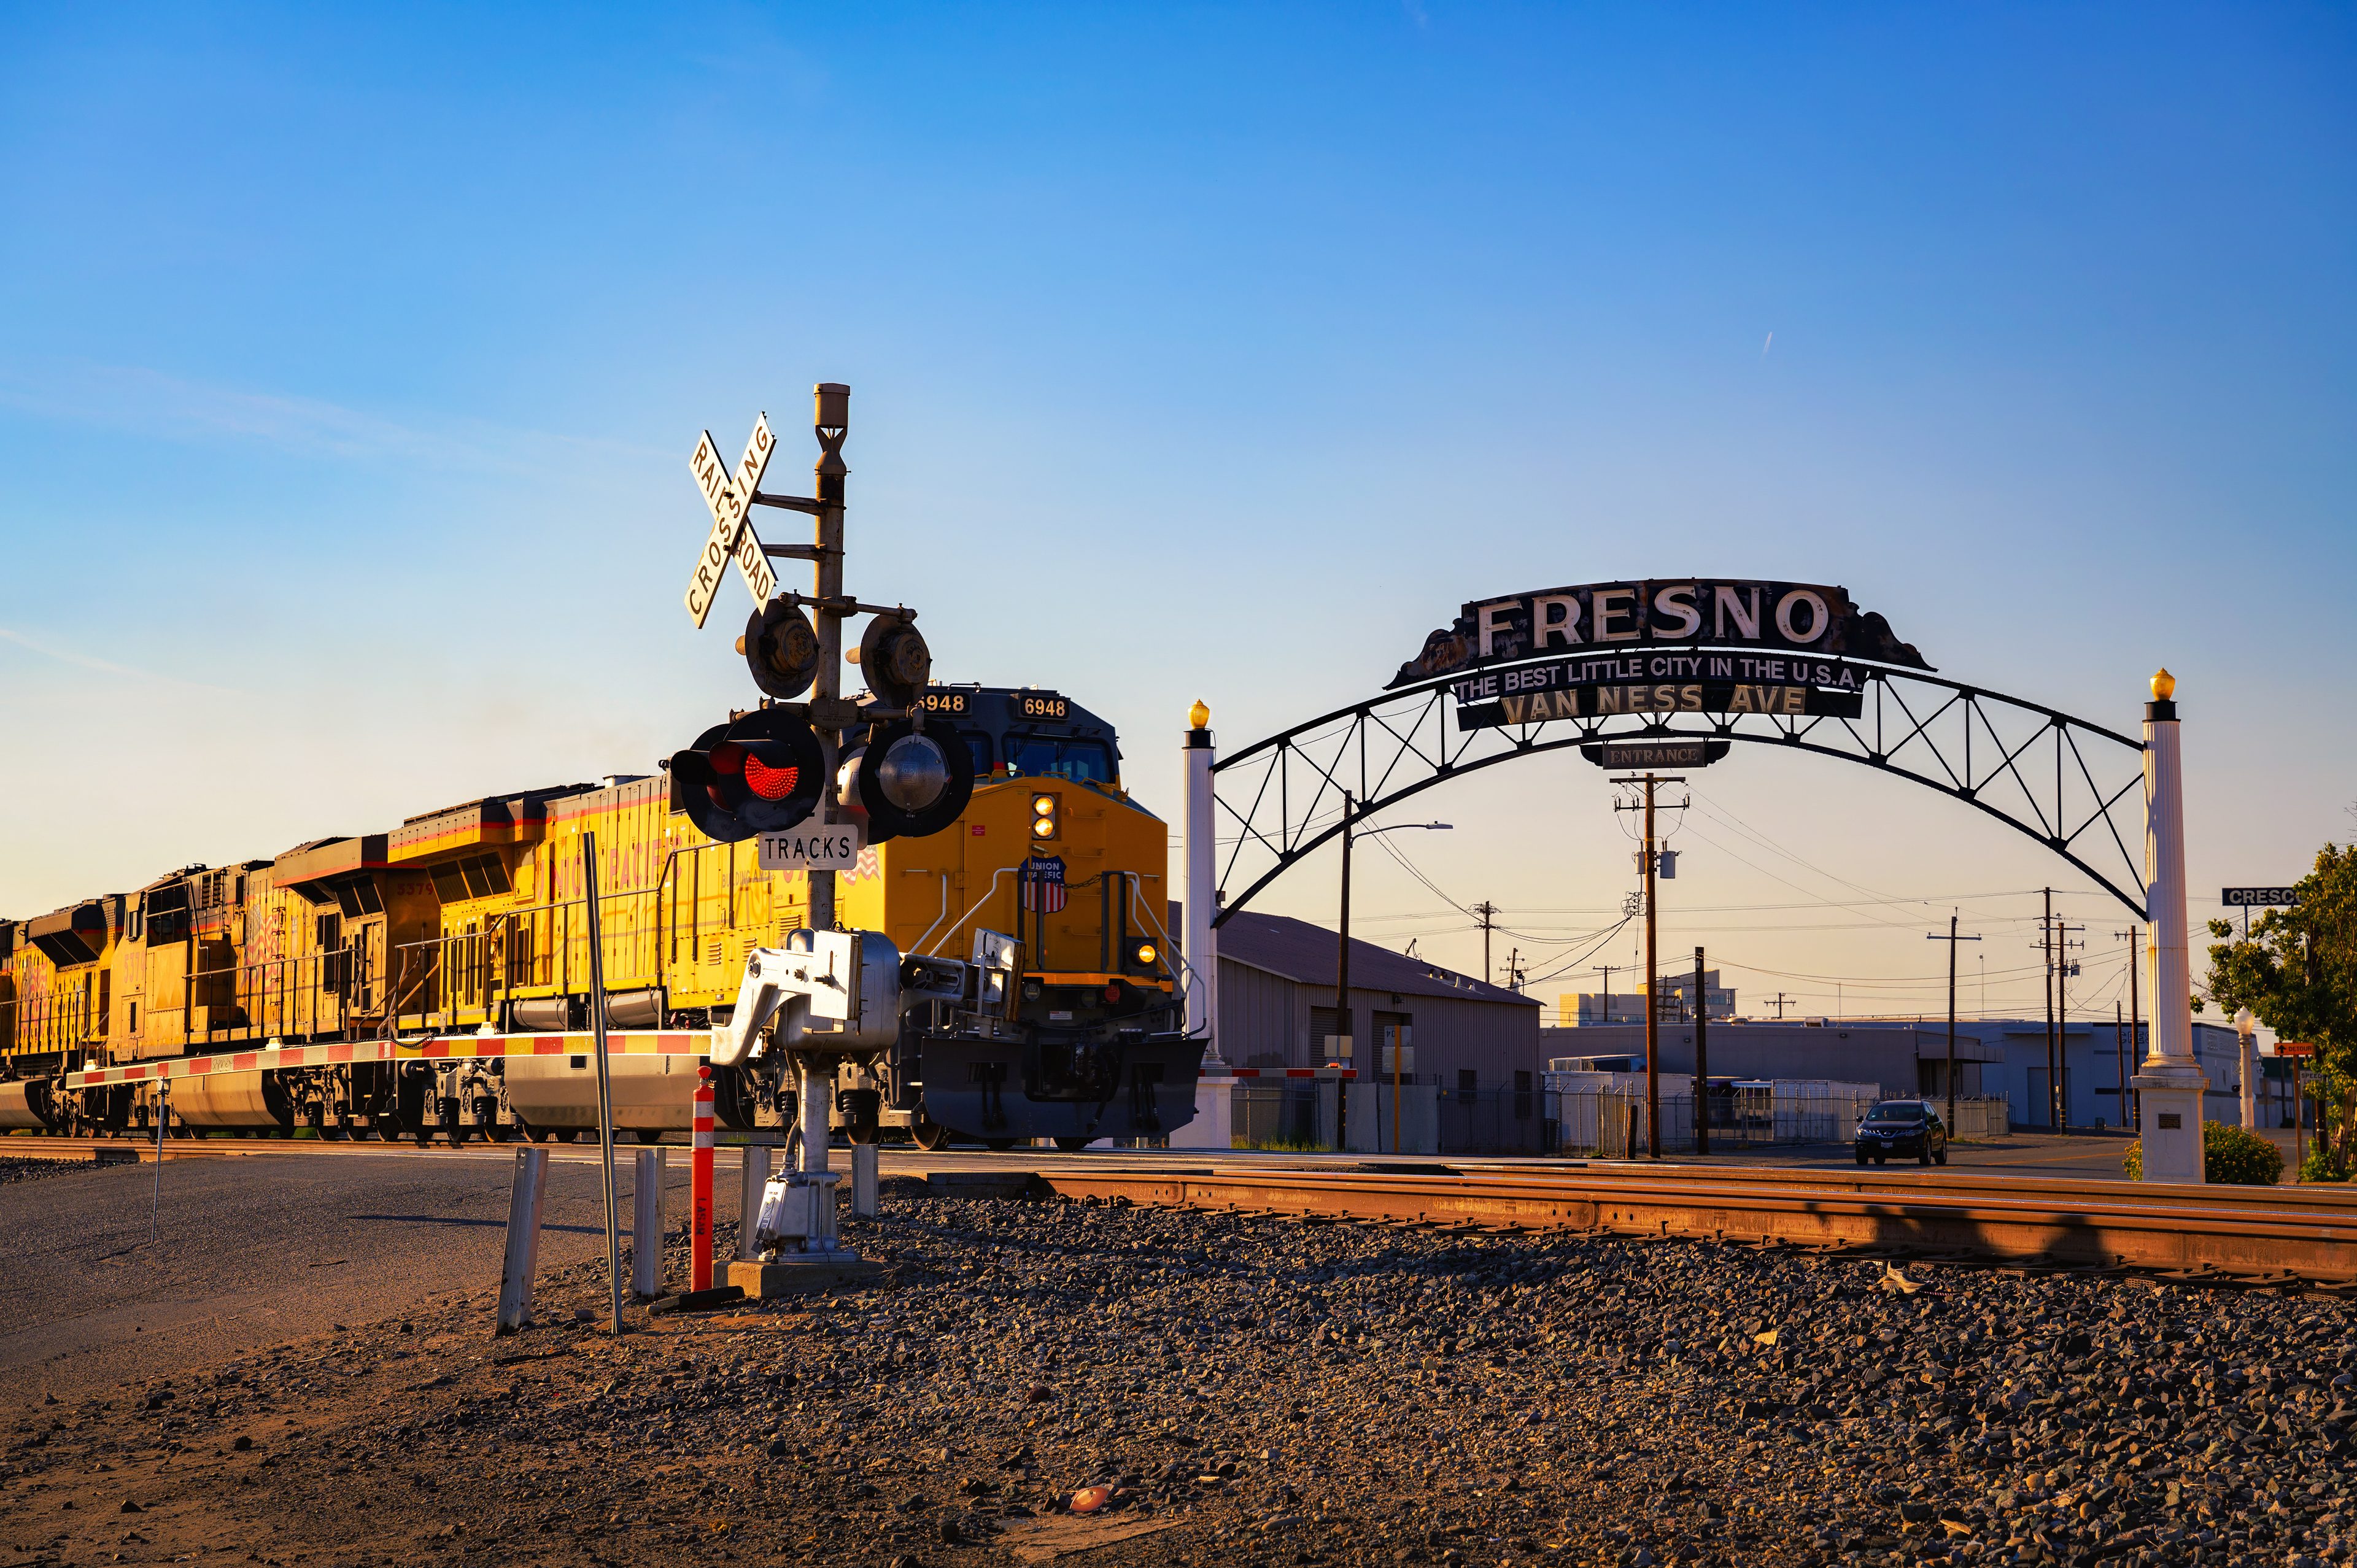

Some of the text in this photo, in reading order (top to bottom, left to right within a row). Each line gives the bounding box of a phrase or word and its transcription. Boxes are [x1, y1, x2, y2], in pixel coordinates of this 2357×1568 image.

[690, 426, 767, 614] CROSSING
[694, 441, 768, 600] RAIL ROAD
[1478, 585, 1829, 658] FRESNO
[1455, 657, 1862, 700] THE BEST LITTLE CITY IN THE U.S.A.
[1024, 698, 1066, 717] 6948
[1501, 685, 1805, 723] VAN NESS AVE
[1611, 749, 1699, 763] ENTRANCE
[765, 836, 850, 859] TRACKS
[537, 834, 683, 902] UNIO PACIFIC
[397, 882, 433, 895] 5379
[2221, 1244, 2253, 1256] NIPPON
